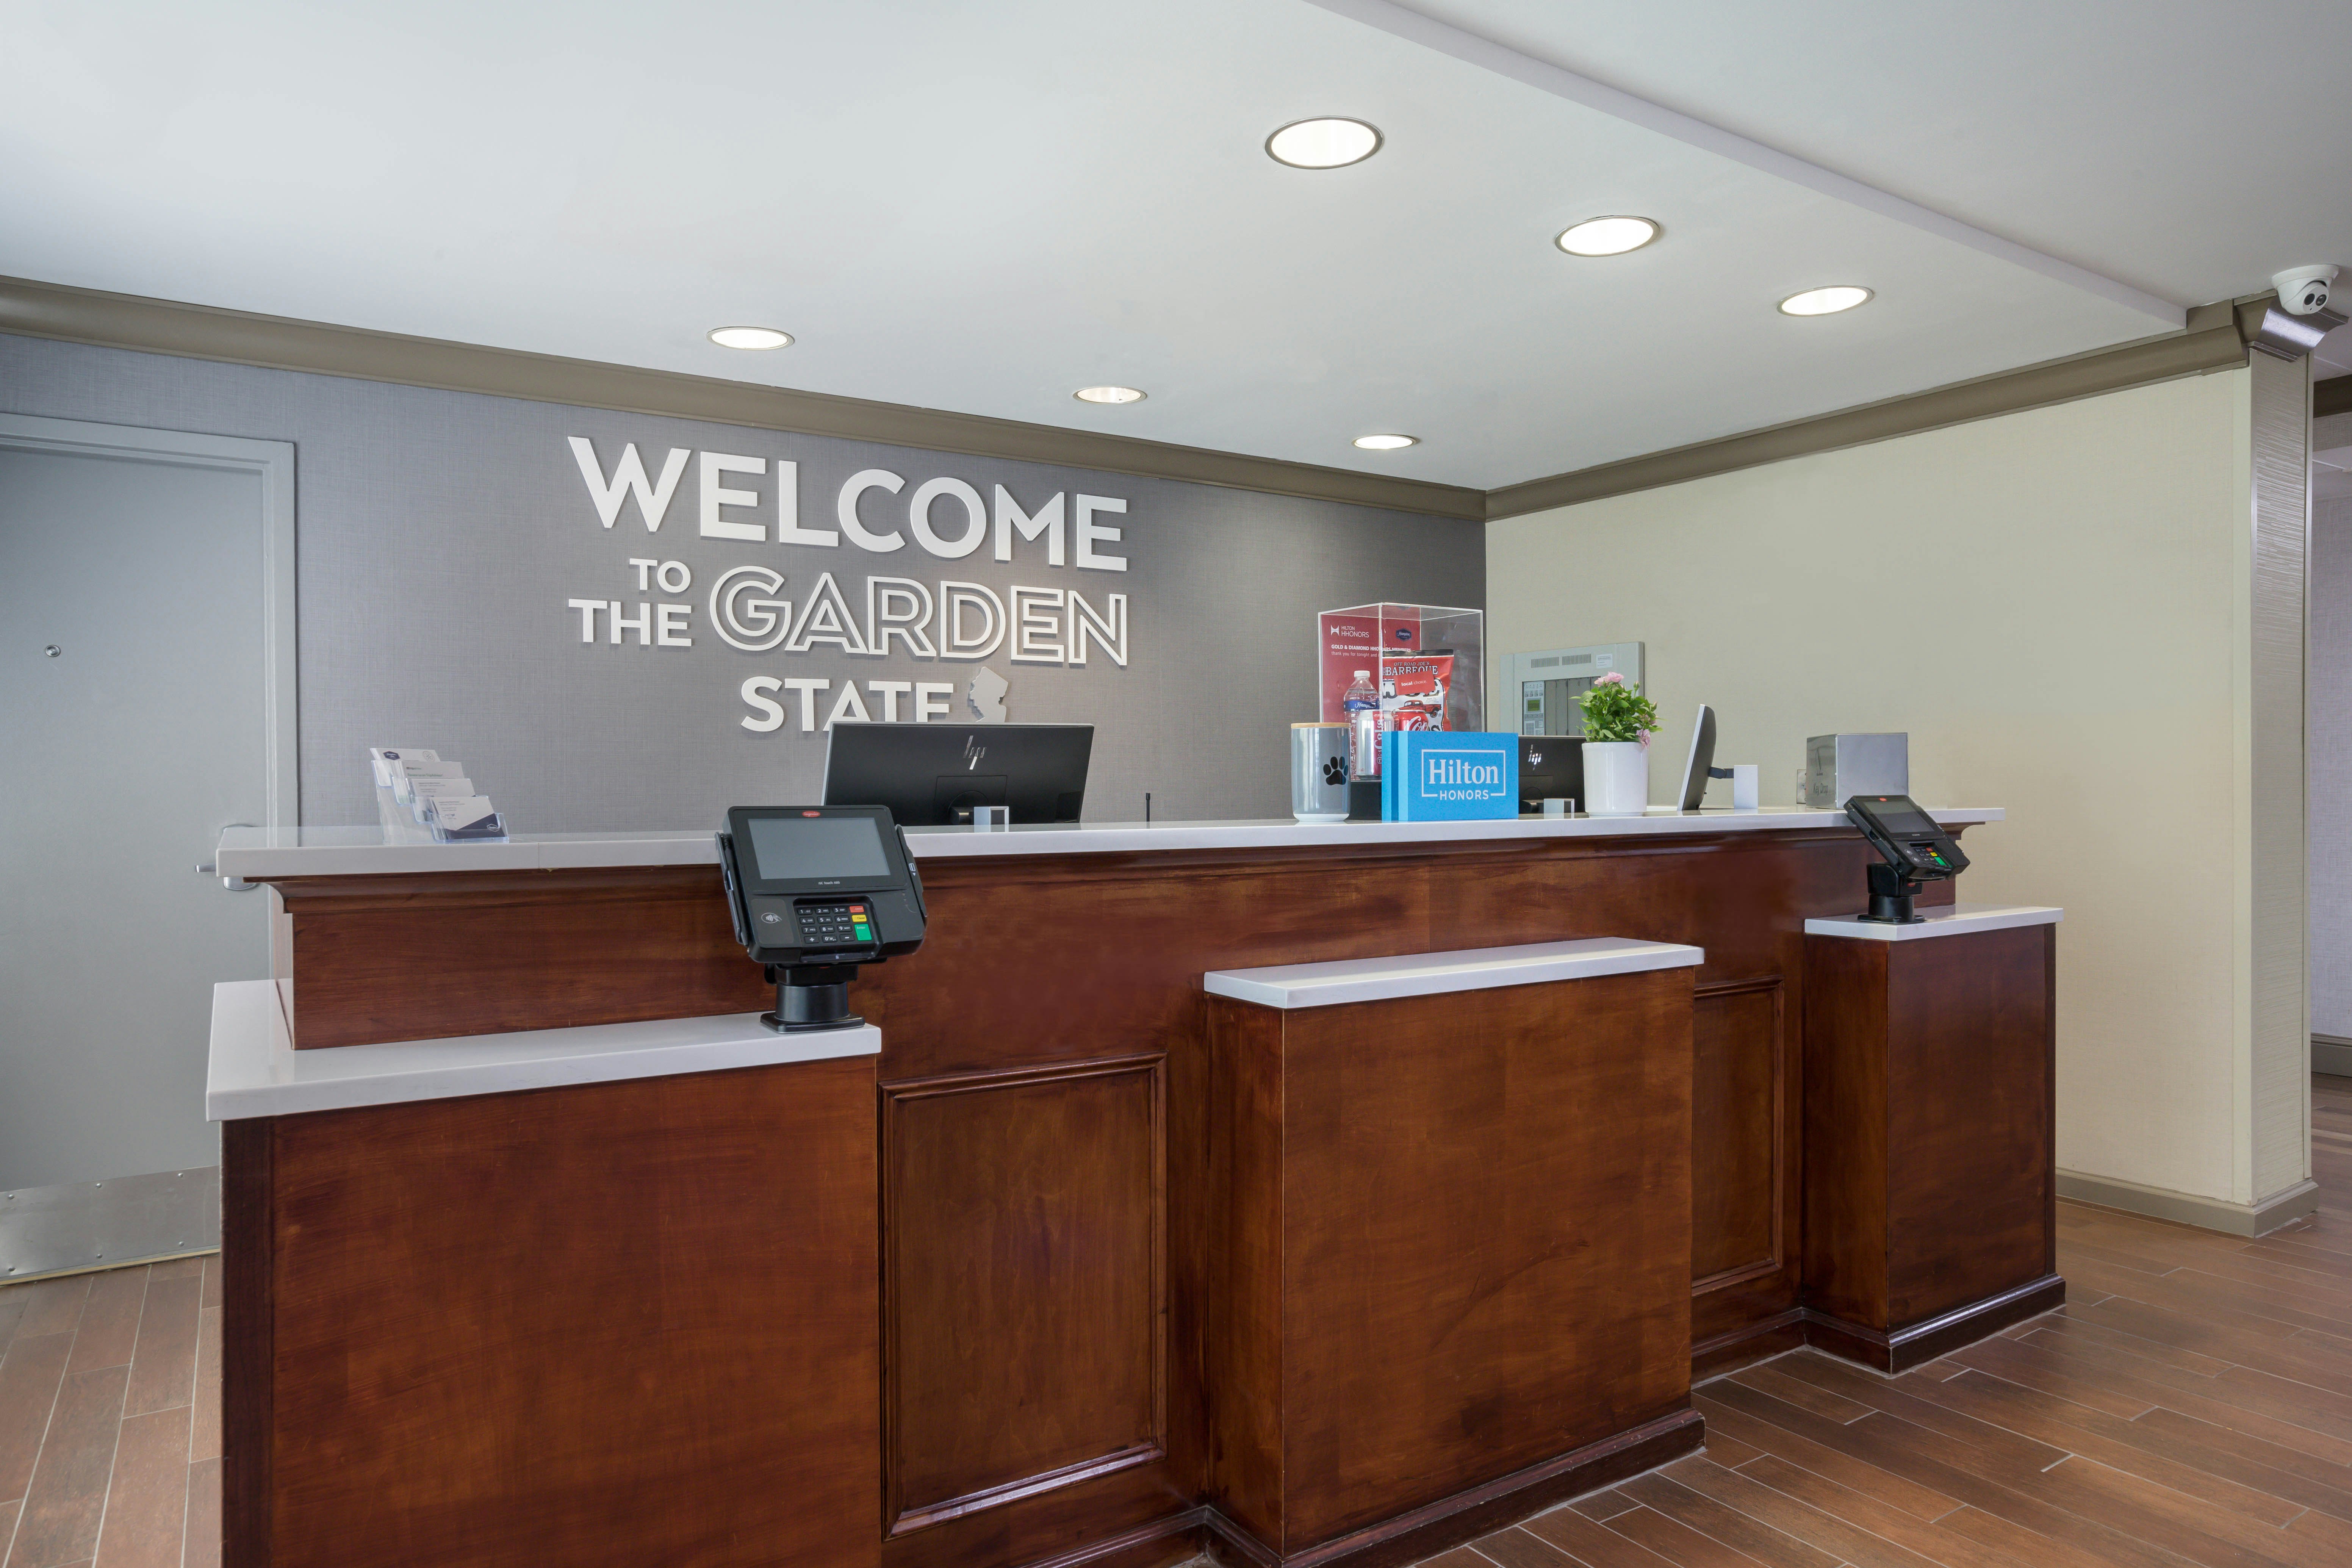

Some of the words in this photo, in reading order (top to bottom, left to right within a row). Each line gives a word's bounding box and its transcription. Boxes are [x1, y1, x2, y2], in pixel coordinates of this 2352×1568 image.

[568, 436, 1128, 571] WELCOME
[629, 558, 691, 593] TO
[568, 598, 692, 647] THE
[709, 565, 1128, 667] GARDEN
[740, 676, 954, 732] STATE
[1429, 759, 1499, 784] Hilton
[1440, 789, 1489, 801] HONORS
[1820, 782, 1828, 797] Drop
